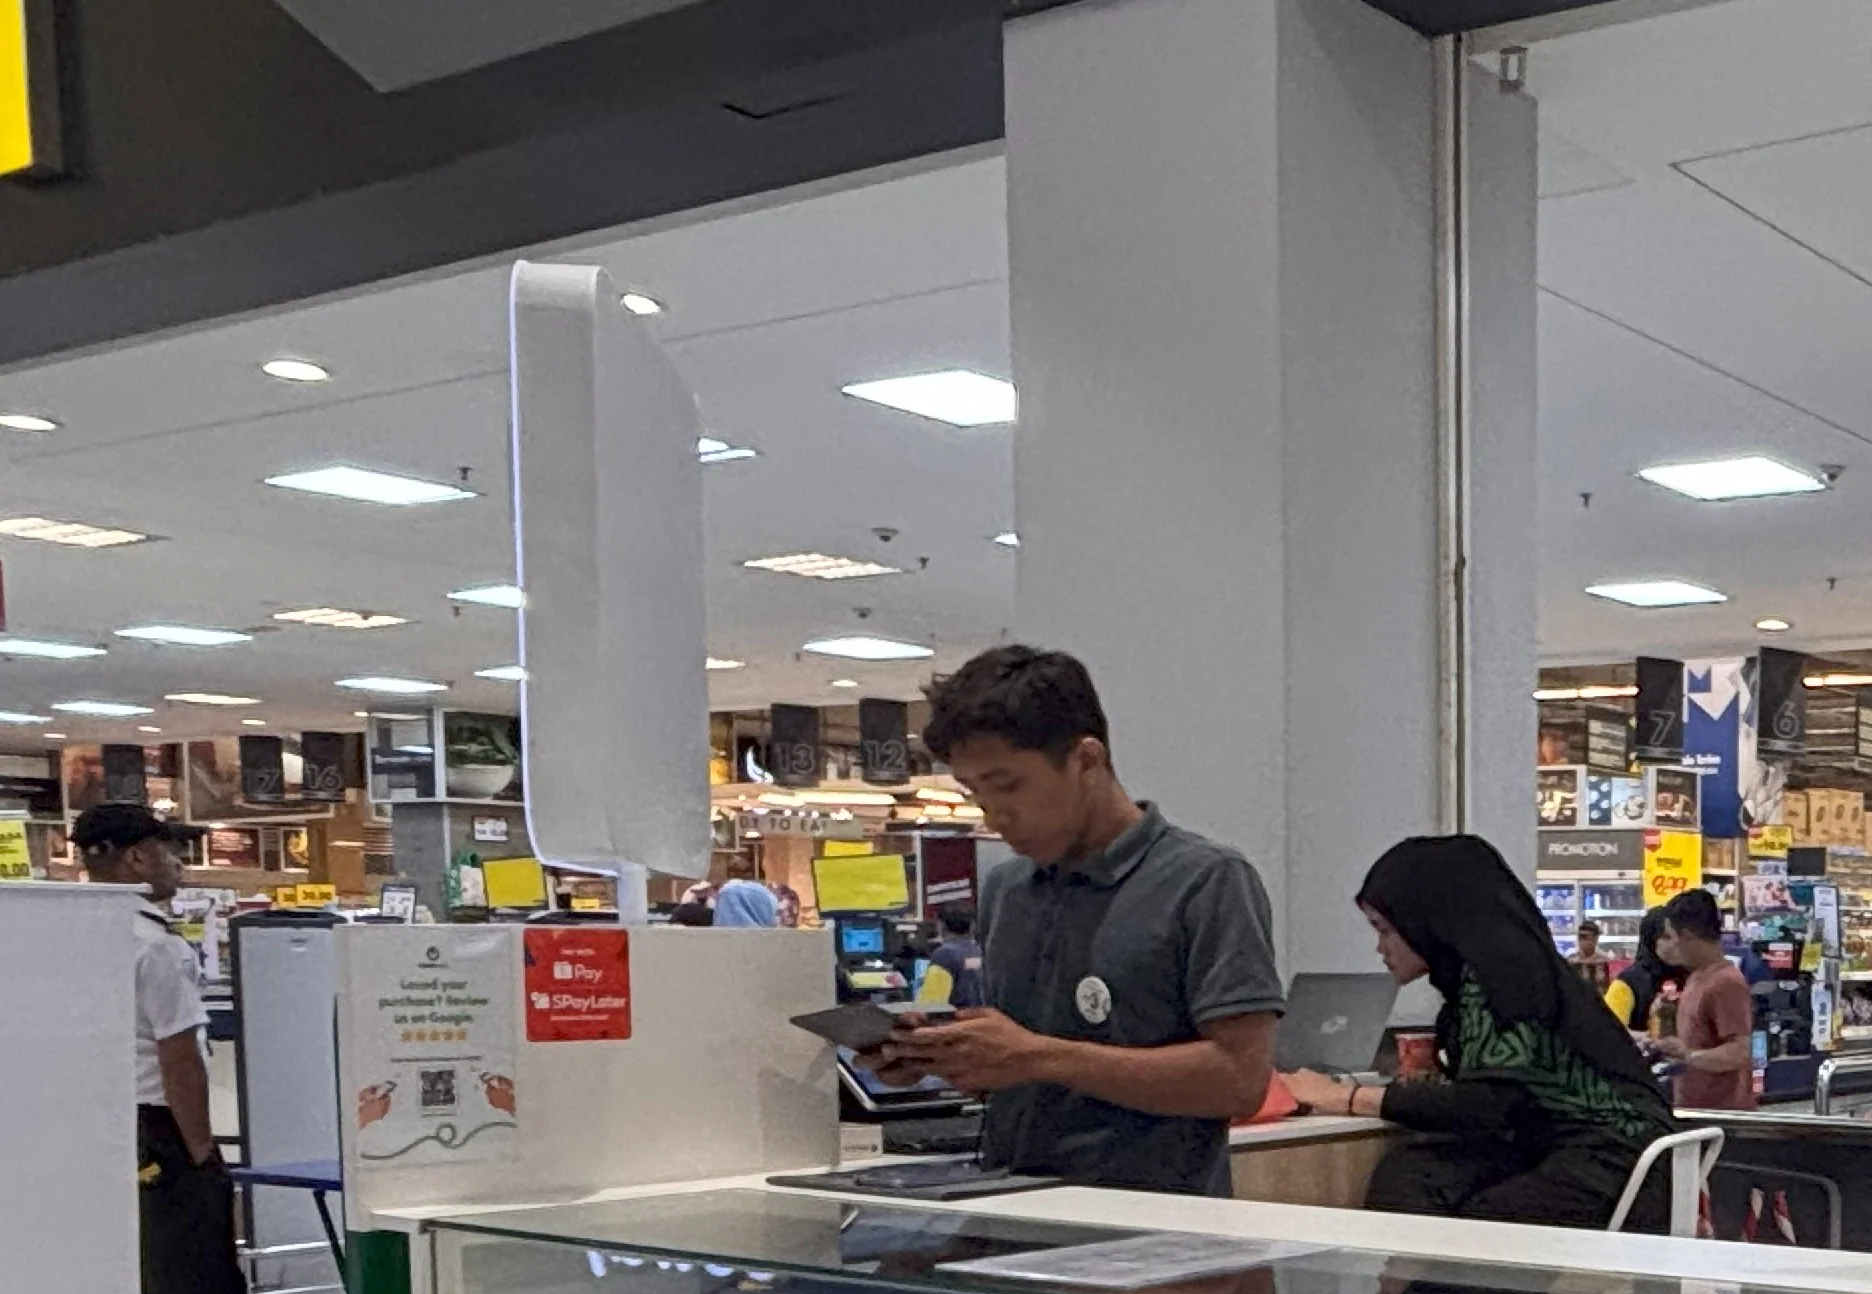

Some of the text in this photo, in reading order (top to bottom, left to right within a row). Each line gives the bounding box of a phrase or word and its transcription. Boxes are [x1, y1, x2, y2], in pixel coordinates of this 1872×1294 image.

[1650, 710, 1678, 746] 7
[1773, 701, 1800, 740] 6
[772, 743, 816, 775] 13
[863, 739, 907, 771] 12
[304, 762, 343, 792] 16
[770, 818, 791, 831] TO
[1548, 843, 1619, 856] PROMOTION
[574, 963, 603, 984] Pay
